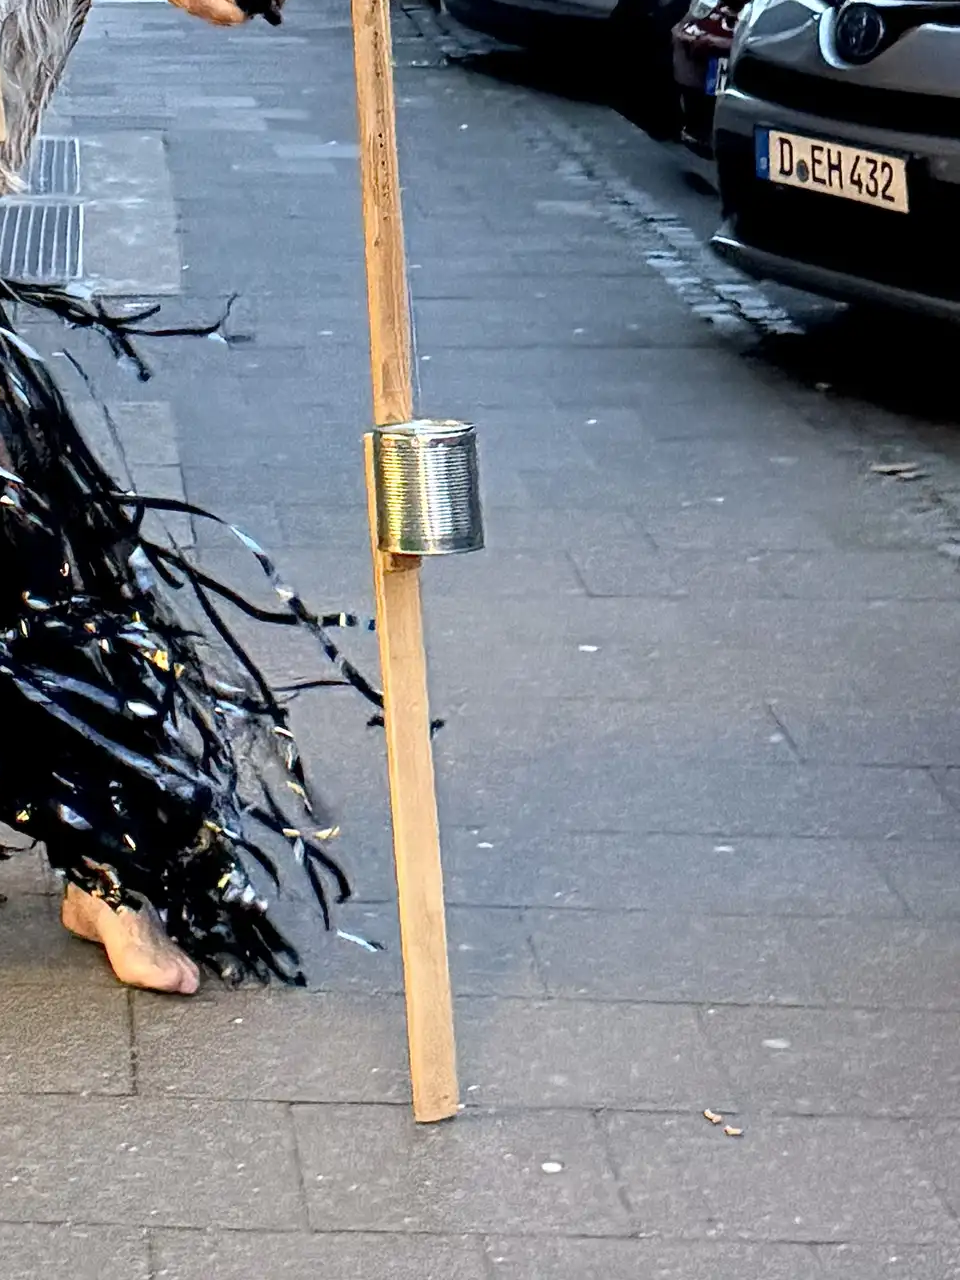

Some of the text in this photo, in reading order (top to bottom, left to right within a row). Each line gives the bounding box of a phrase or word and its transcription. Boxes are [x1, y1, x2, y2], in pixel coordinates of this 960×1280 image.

[778, 136, 896, 203] D EH 432
